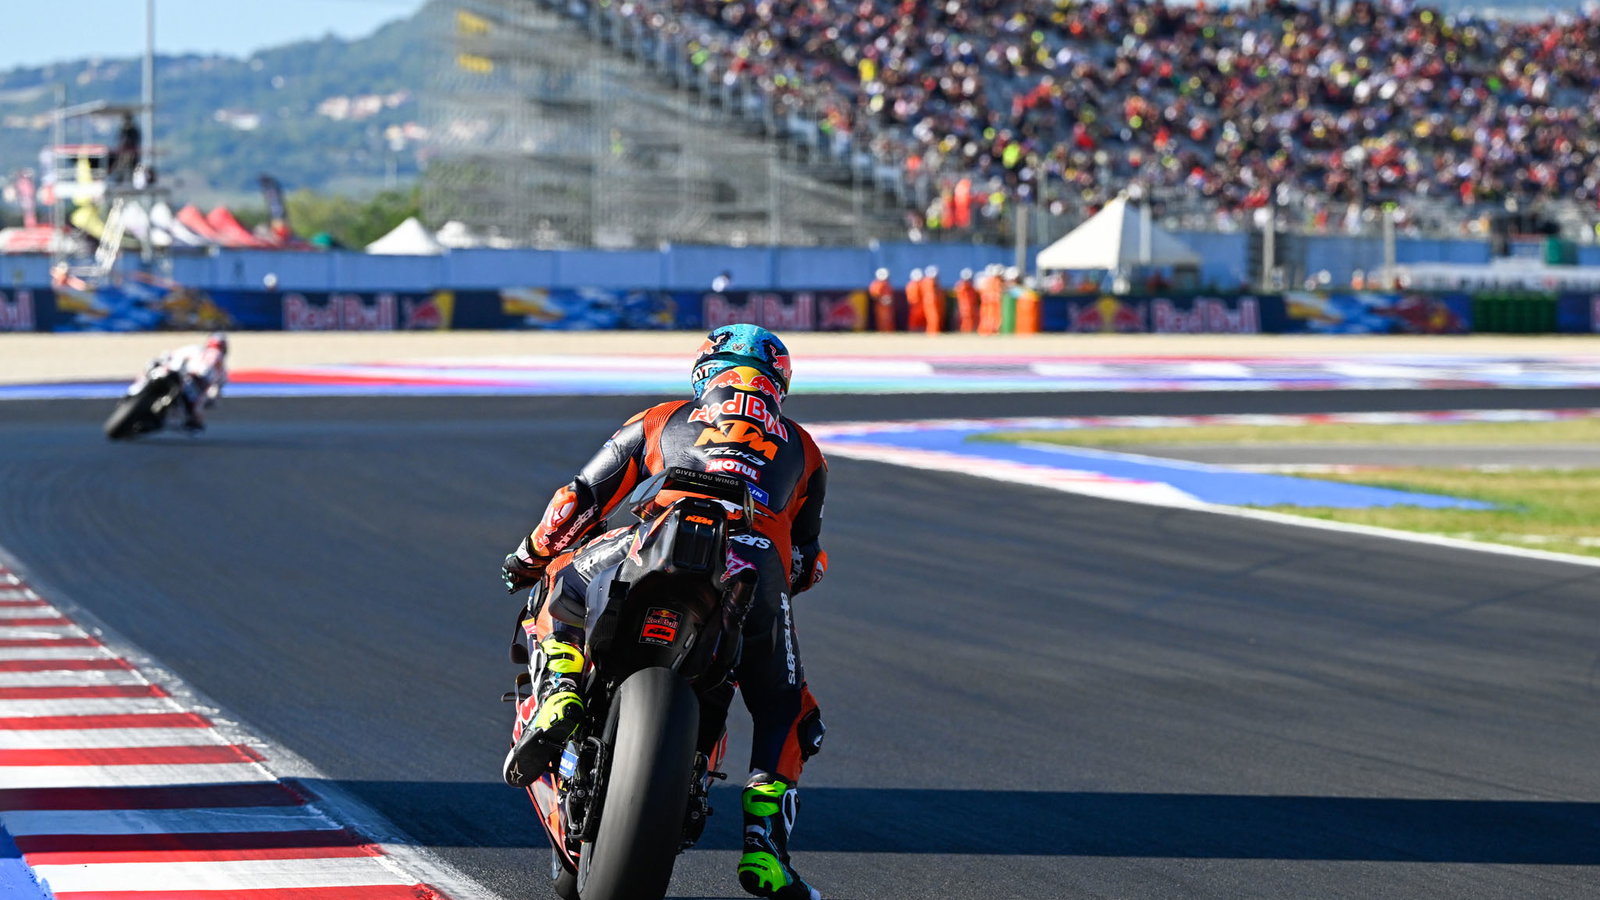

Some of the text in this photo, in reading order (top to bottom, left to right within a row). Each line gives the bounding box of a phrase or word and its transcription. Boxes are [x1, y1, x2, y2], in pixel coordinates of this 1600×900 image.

[687, 392, 789, 443] Red Bull
[693, 419, 779, 461] KTM
[703, 446, 766, 466] TECH3
[675, 468, 740, 487] GIVES YOU WINGS
[708, 460, 758, 481] MOTUL
[685, 515, 714, 526] KTM
